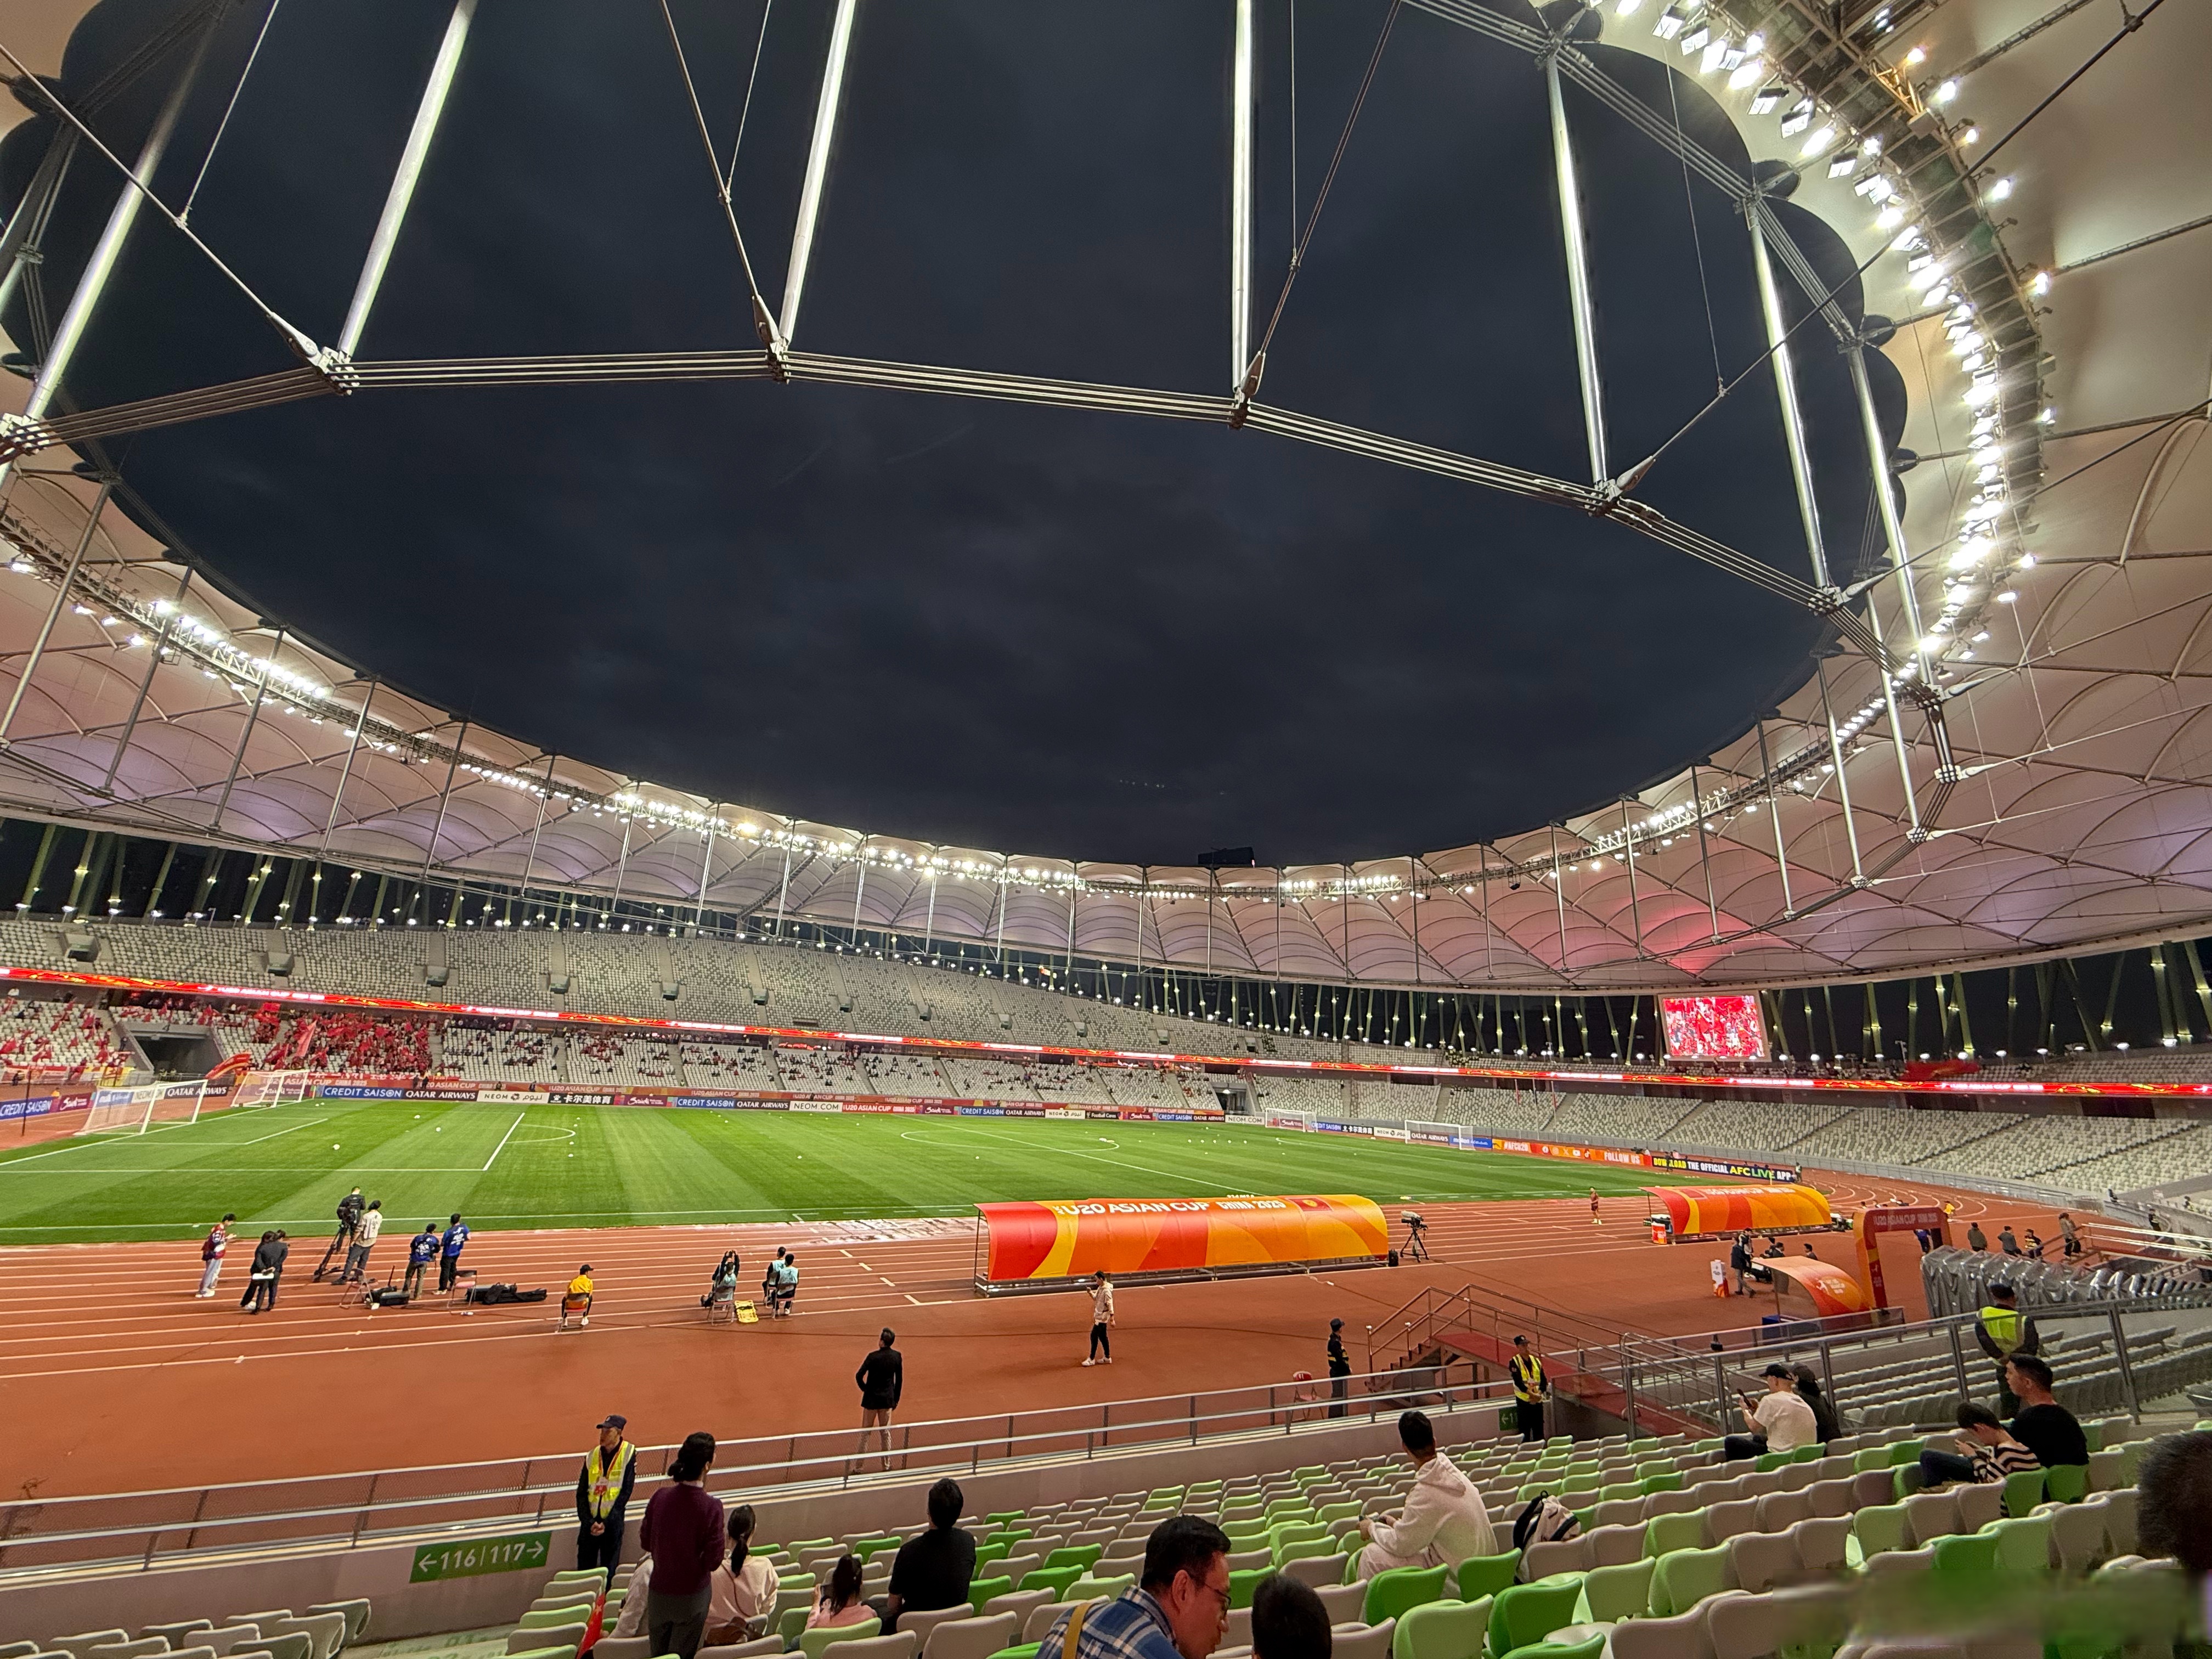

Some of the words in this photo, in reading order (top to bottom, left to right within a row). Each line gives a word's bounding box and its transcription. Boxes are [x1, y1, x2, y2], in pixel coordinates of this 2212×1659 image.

[167, 1088, 194, 1097] QATAR
[194, 1086, 227, 1096] ARWAYS
[325, 1087, 362, 1096] CREDIT
[364, 1088, 402, 1097] SAISON
[438, 1091, 476, 1099] AIRWAYS
[563, 1094, 612, 1104] 卡尔美体育
[1, 1103, 25, 1116] CREDIT
[25, 1099, 52, 1113] SAISON
[1604, 1152, 1630, 1163] FOLLOW
[1631, 1154, 1640, 1164] US
[1654, 1158, 1686, 1169] DOWLOAD
[1688, 1161, 1700, 1170] THE
[1701, 1163, 1728, 1173] OFFICIAL
[1730, 1167, 1751, 1176] AFC
[1751, 1169, 1775, 1179] LIVE
[1777, 1171, 1791, 1181] APP
[1060, 1204, 1106, 1215] U20
[1108, 1203, 1171, 1213] ASIAN
[1169, 1201, 1210, 1211] CUP
[1216, 1201, 1256, 1210] CHINA
[1251, 1200, 1286, 1209] 2025
